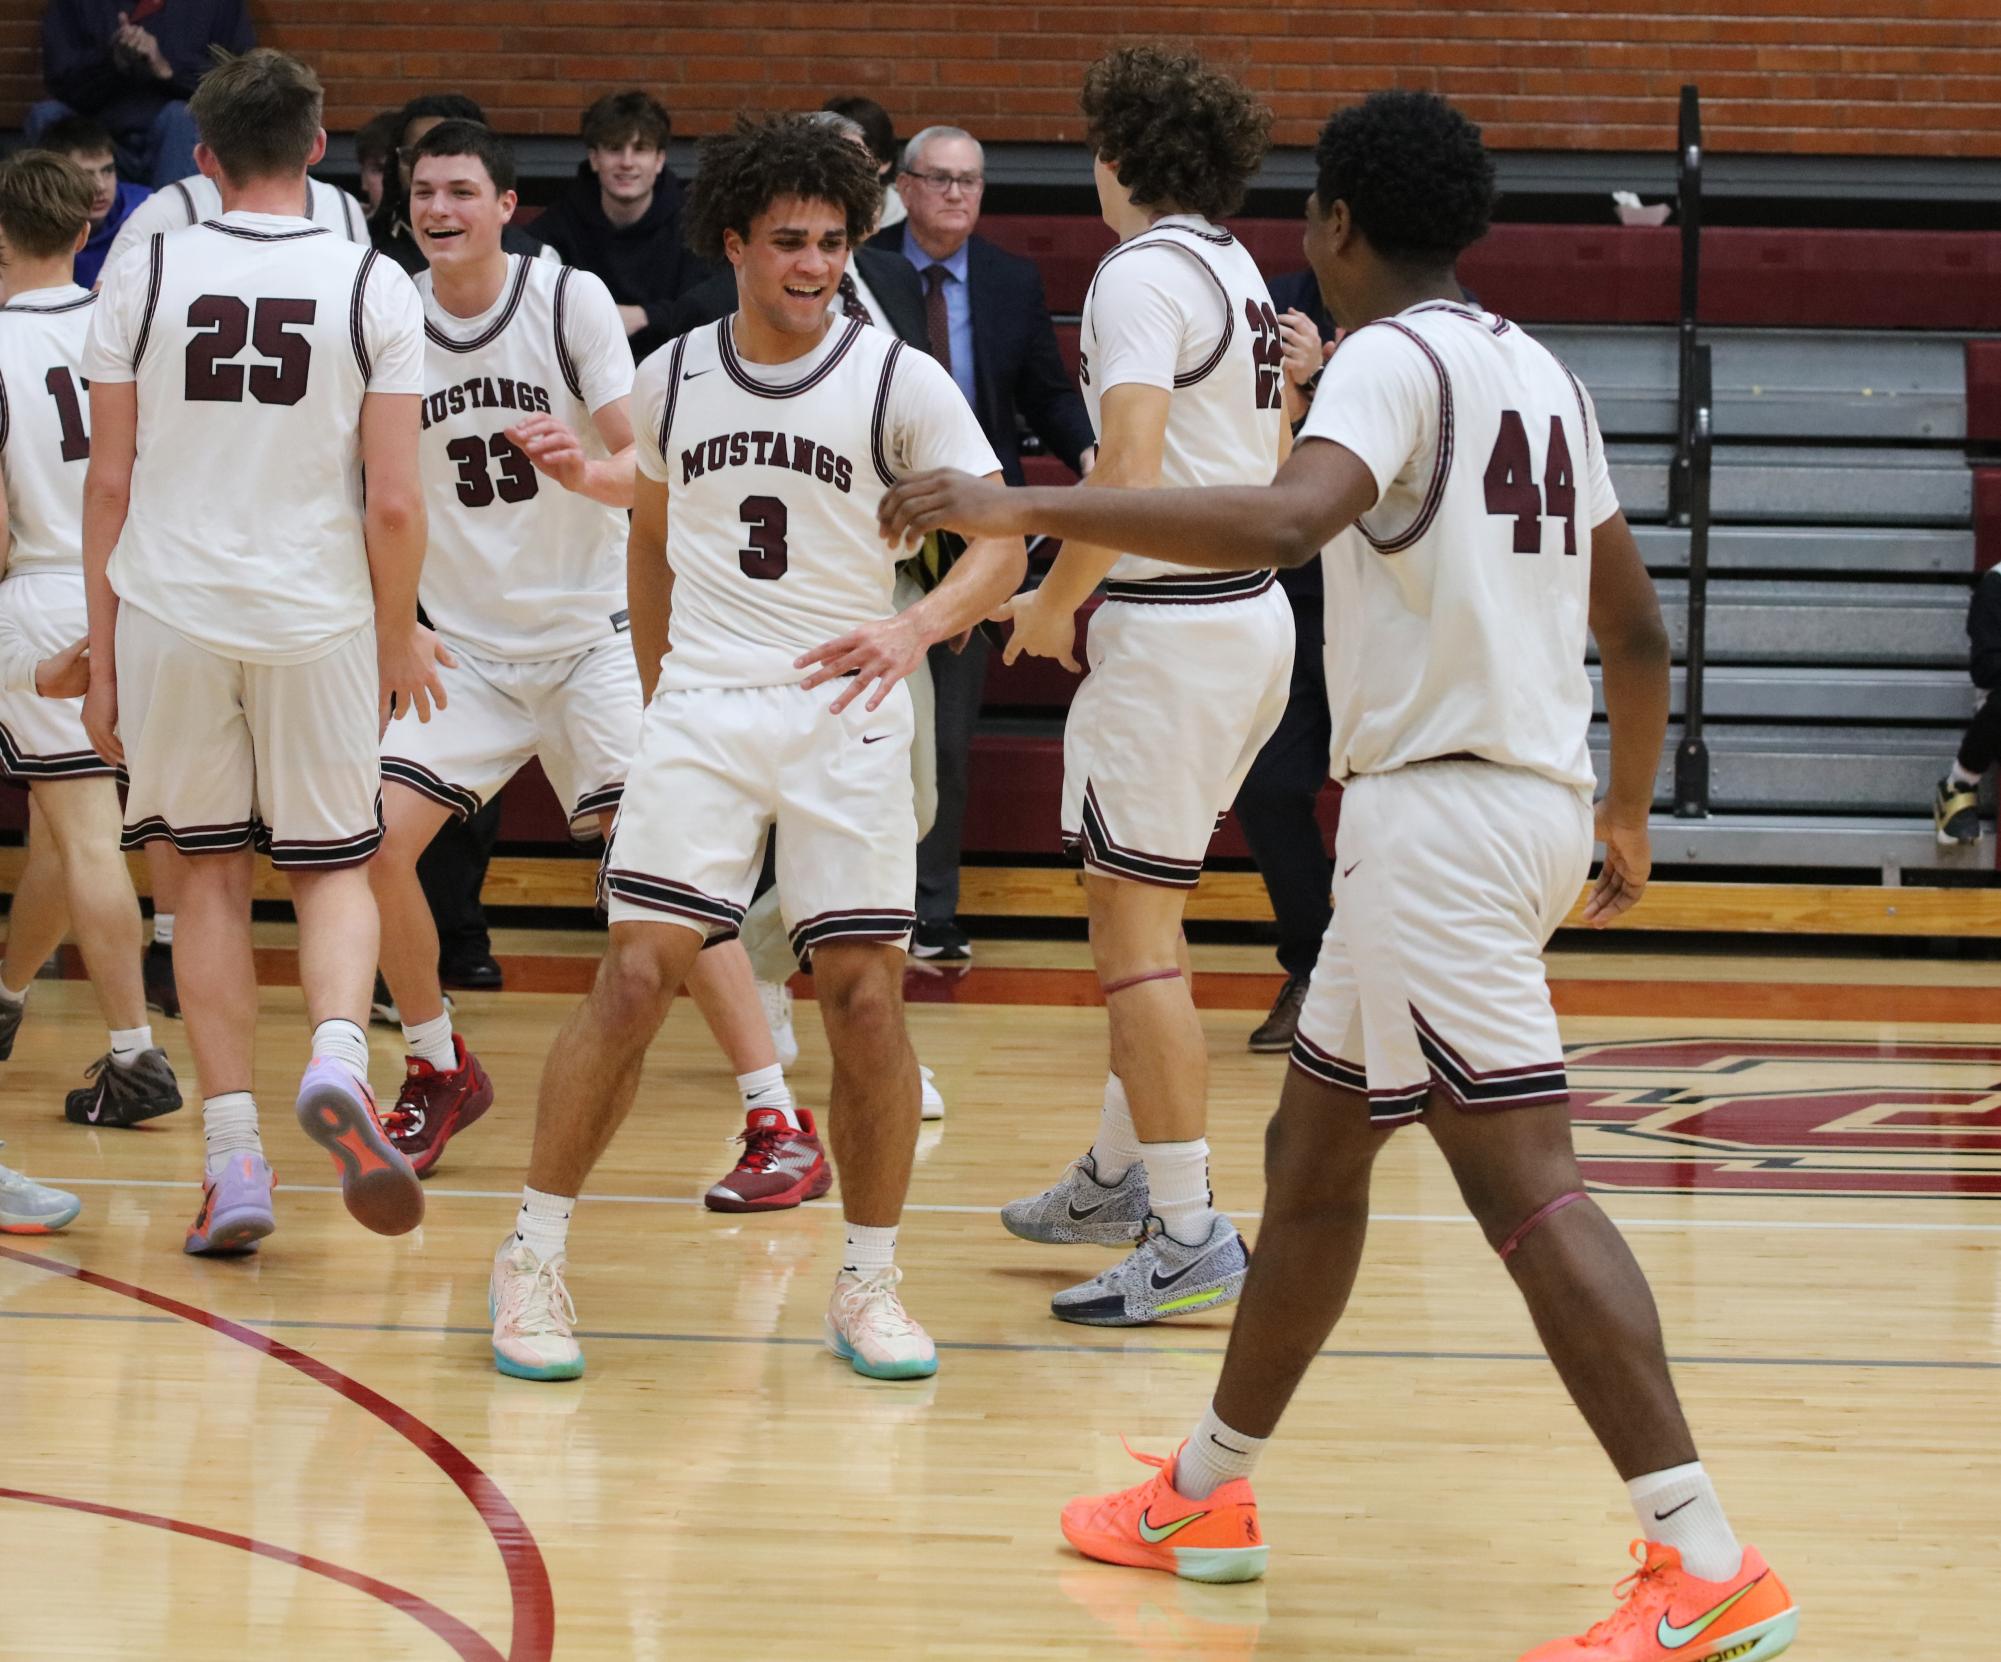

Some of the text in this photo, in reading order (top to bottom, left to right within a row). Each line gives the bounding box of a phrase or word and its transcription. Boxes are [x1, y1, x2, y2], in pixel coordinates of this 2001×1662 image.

[185, 294, 317, 406] 25
[1245, 298, 1284, 409] 22
[45, 366, 90, 462] 1
[446, 432, 539, 508] 33
[681, 431, 853, 494] MUSTANGS
[1483, 410, 1577, 555] 44
[739, 495, 788, 581] 3
